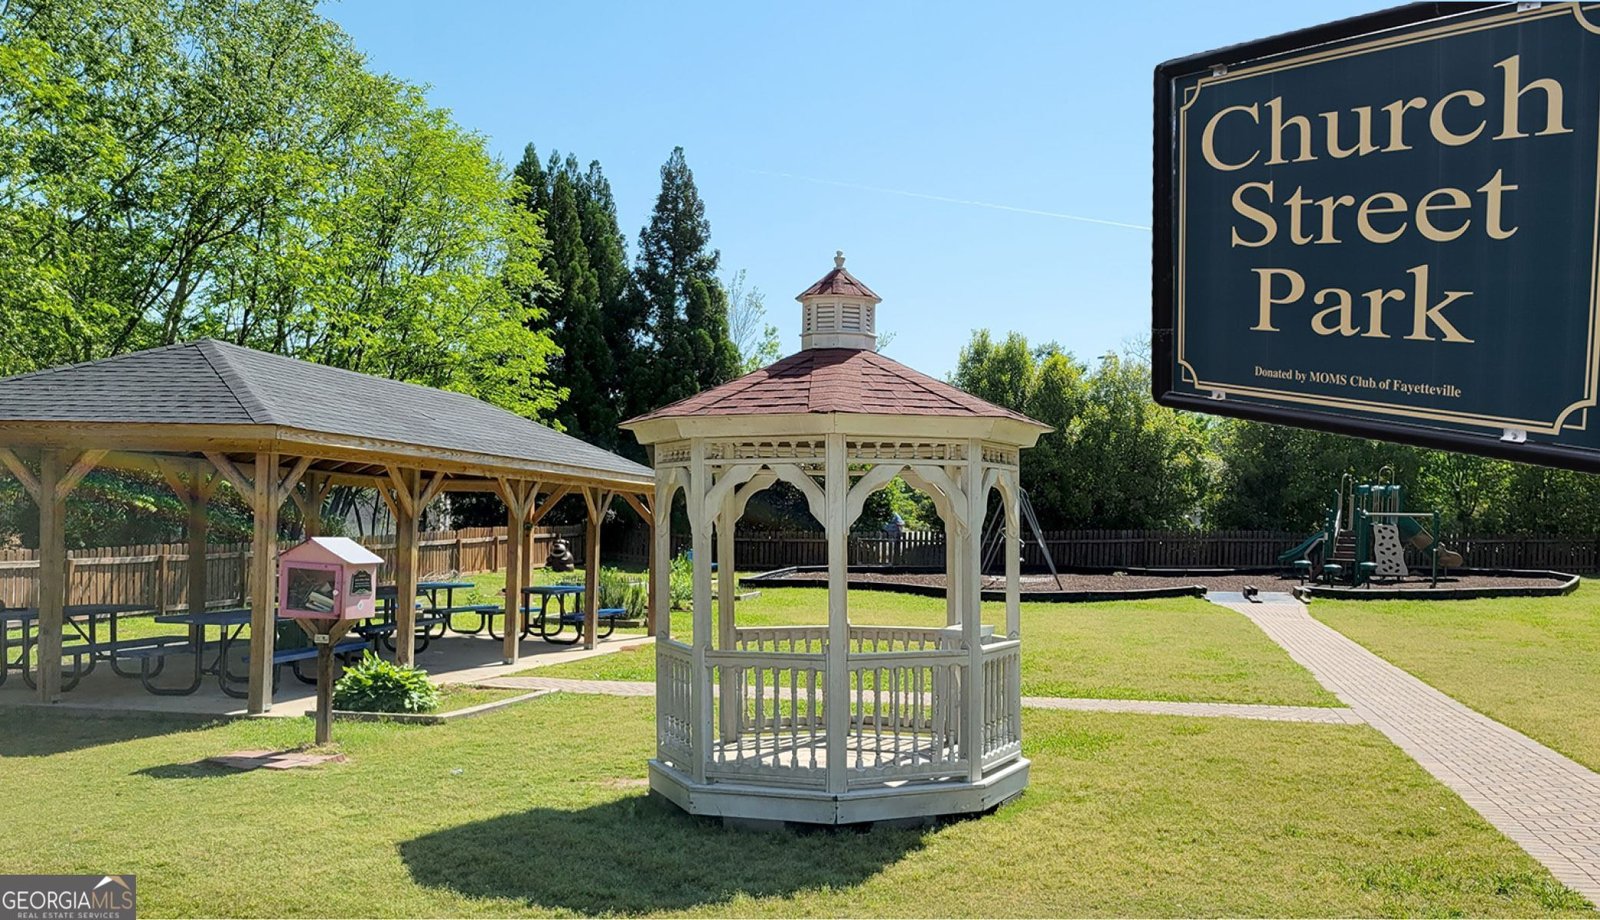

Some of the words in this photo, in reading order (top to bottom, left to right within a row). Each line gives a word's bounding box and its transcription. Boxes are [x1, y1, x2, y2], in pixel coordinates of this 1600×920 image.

[1201, 54, 1574, 172] Church
[1231, 168, 1519, 248] Street
[1249, 264, 1475, 344] Park
[1254, 365, 1293, 380] Donated
[1295, 370, 1307, 383] by
[1309, 371, 1347, 386] MOMS
[1349, 375, 1376, 389] Club
[1378, 379, 1391, 390] of
[1393, 379, 1462, 398] Fayetteville
